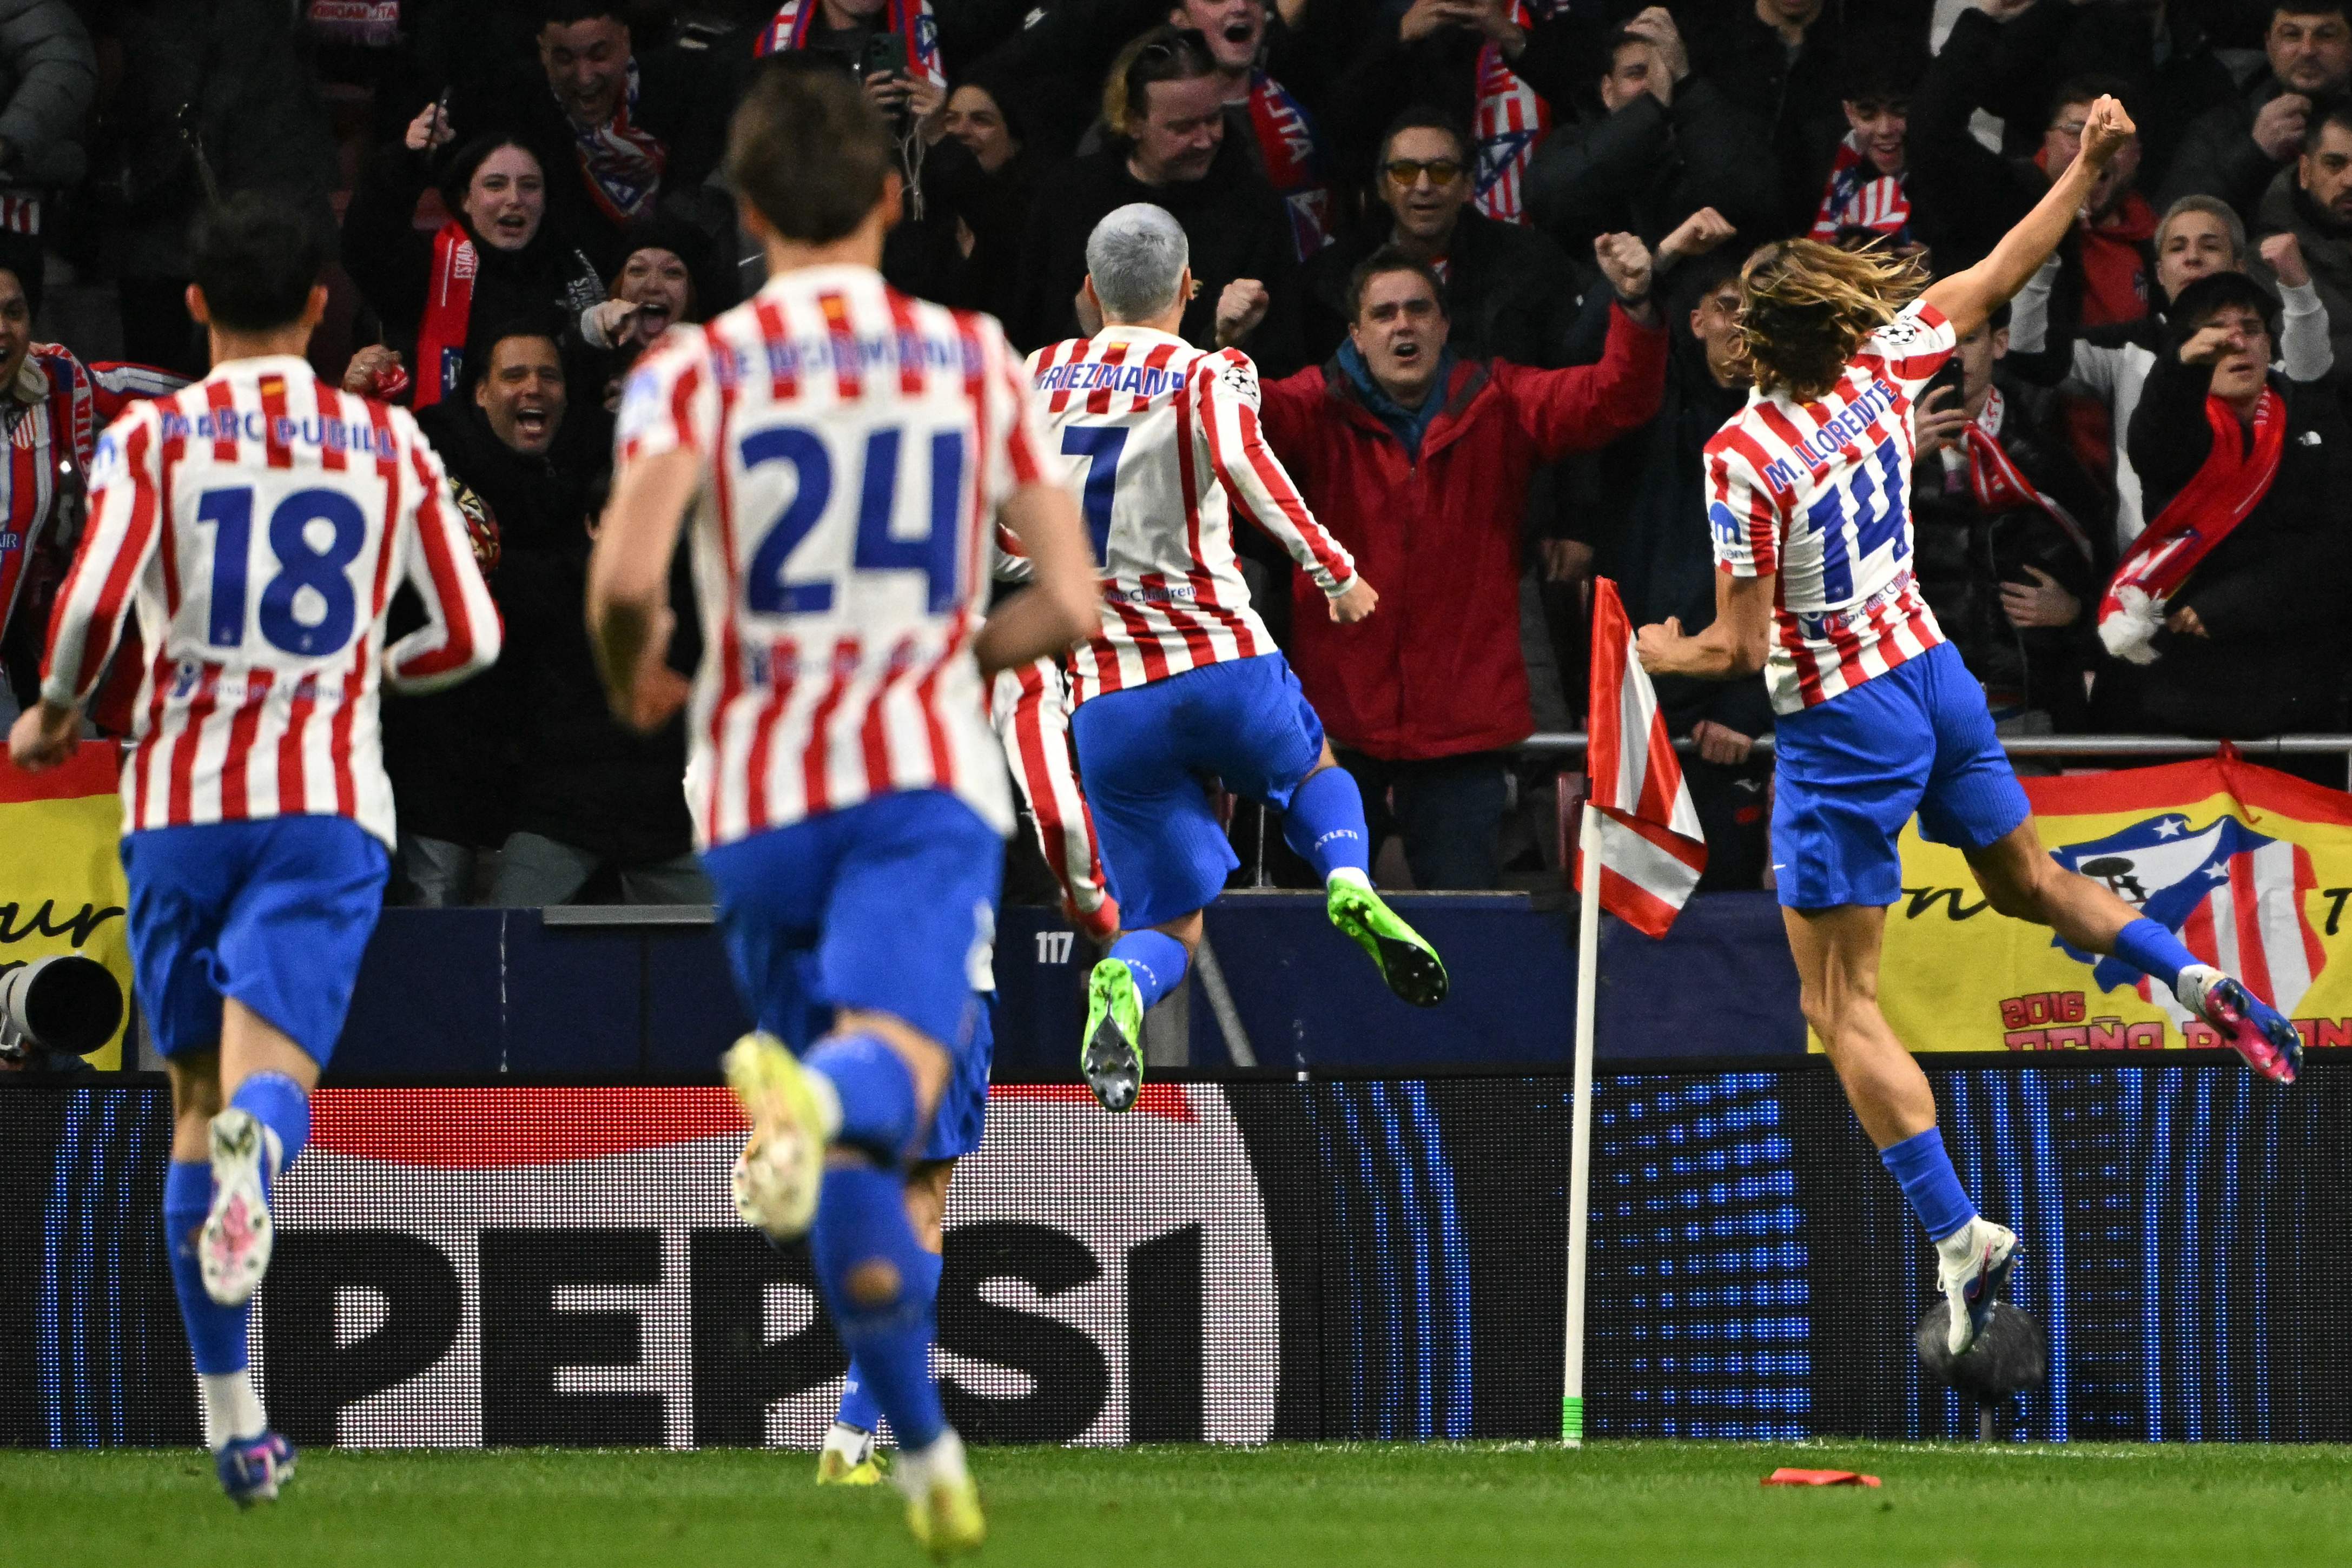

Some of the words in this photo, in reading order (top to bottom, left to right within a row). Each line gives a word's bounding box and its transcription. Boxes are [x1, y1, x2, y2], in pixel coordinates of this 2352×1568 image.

[162, 408, 264, 441] MARC
[275, 416, 398, 460] PUBILL
[1061, 426, 1129, 567] 7
[1763, 457, 1805, 493] M.
[1794, 378, 1898, 468] LLORENTE
[197, 487, 366, 657] 18
[740, 426, 964, 614] 24
[1807, 436, 1910, 604] 14
[1035, 931, 1074, 963] 117
[262, 1221, 1203, 1446] PEPSI
